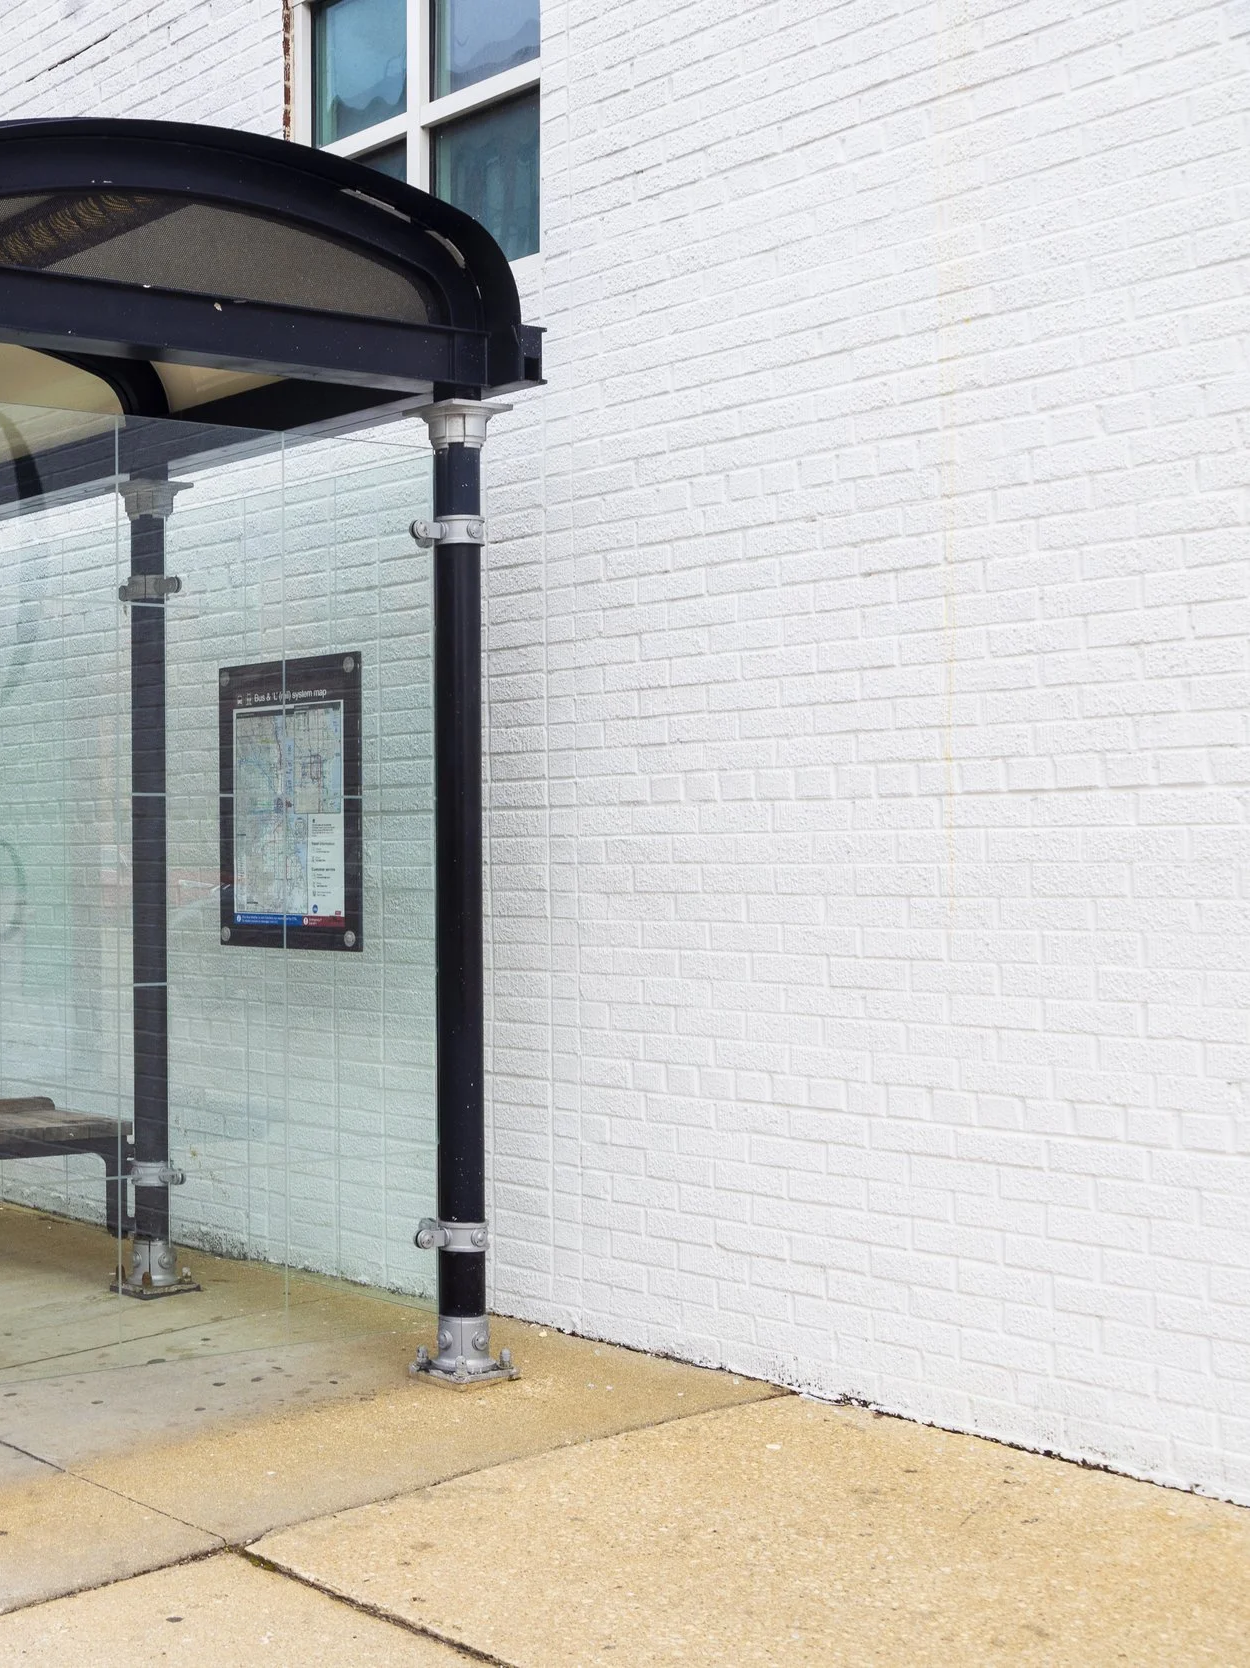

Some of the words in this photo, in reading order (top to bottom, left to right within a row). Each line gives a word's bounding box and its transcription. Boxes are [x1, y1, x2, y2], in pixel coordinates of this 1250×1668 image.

[254, 693, 265, 702] Bus
[279, 692, 291, 702] (ril)
[292, 690, 312, 700] system
[313, 689, 327, 699] map
